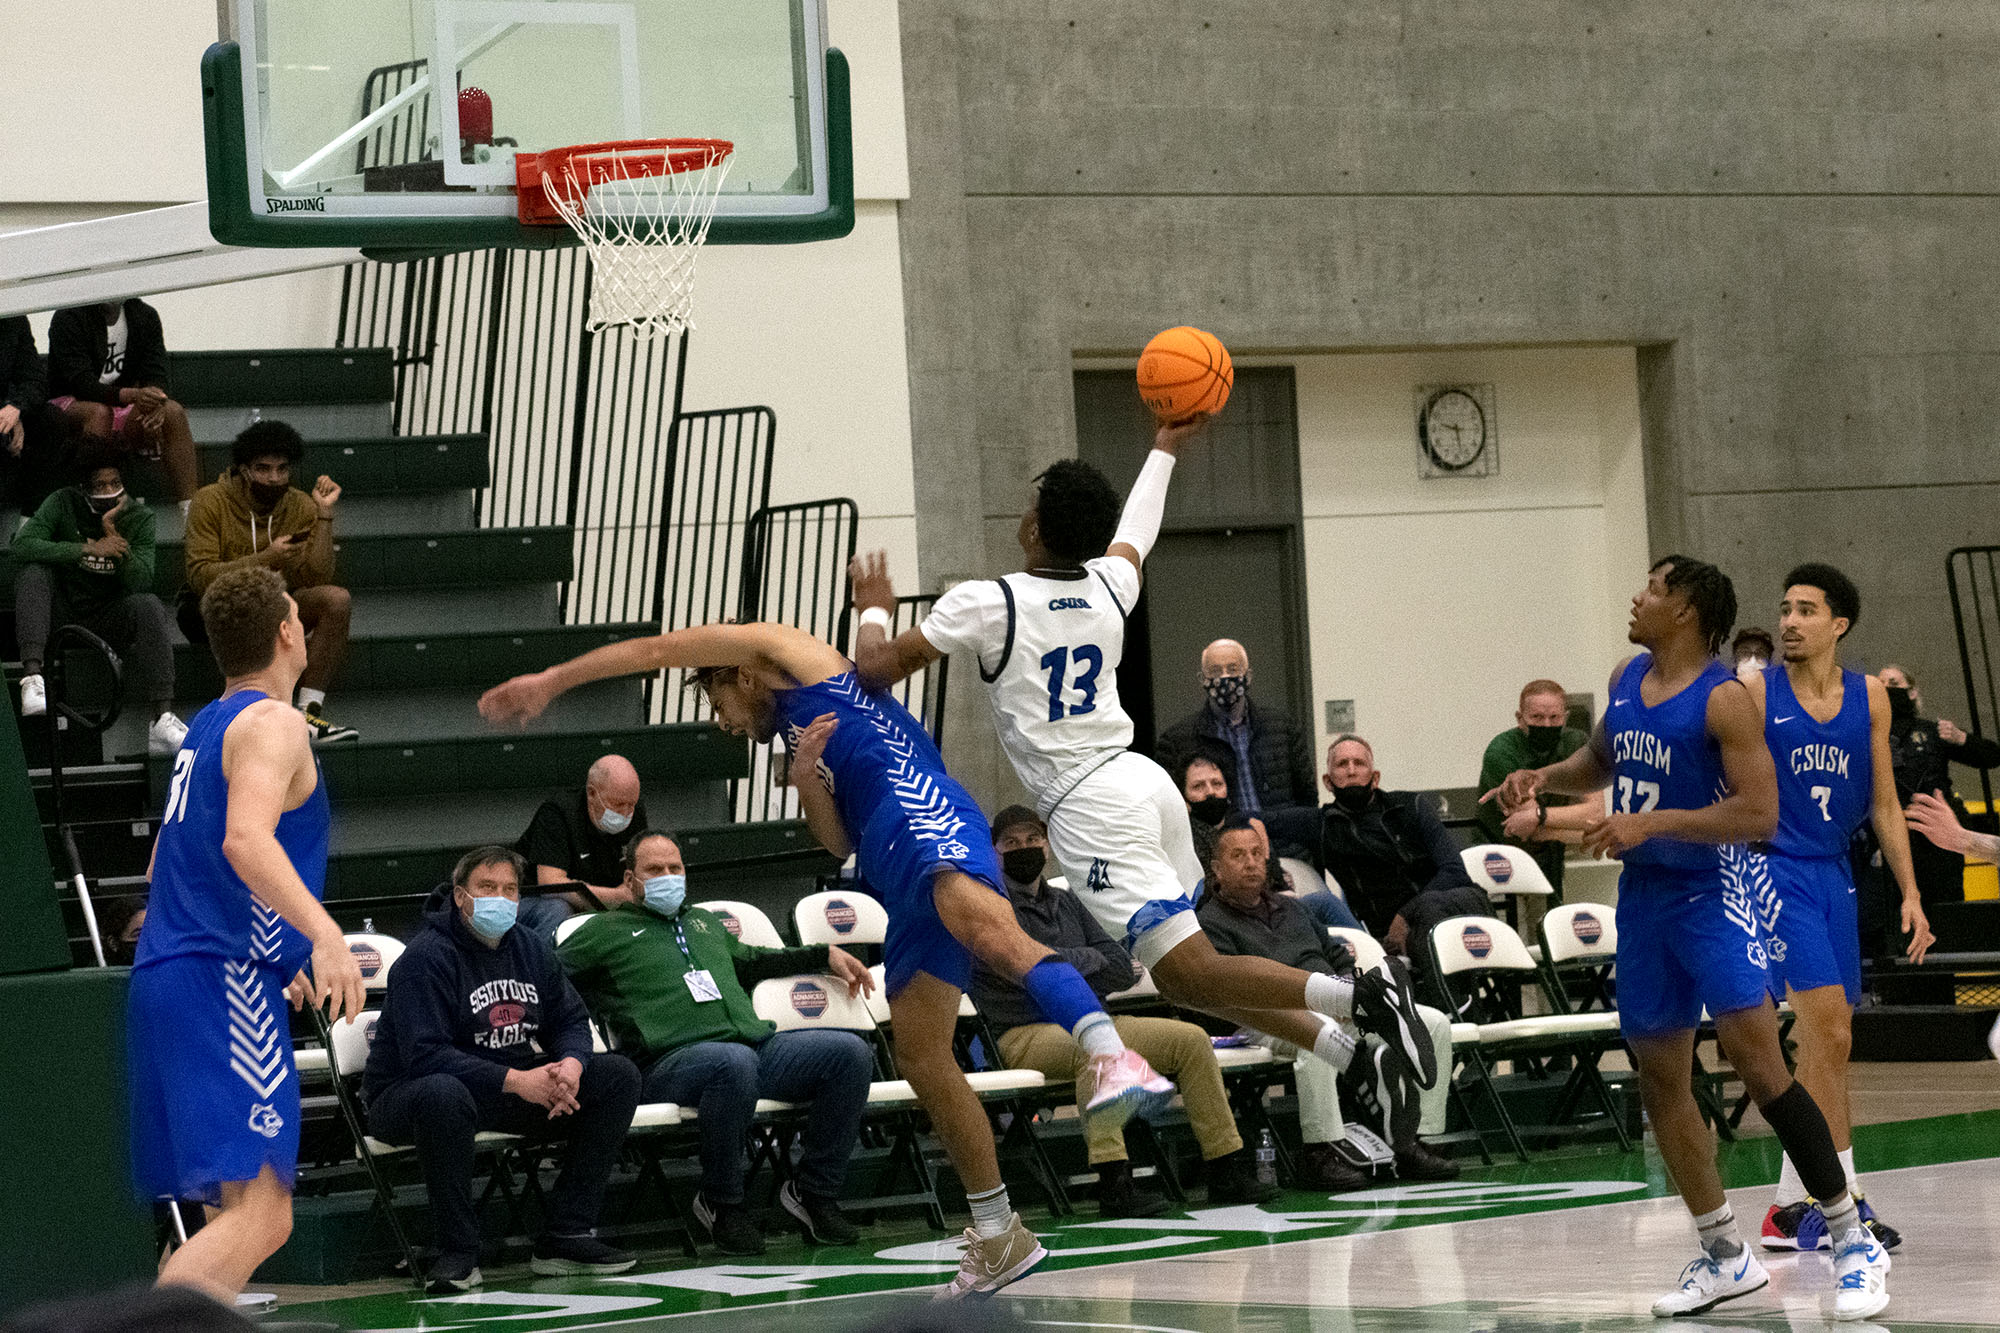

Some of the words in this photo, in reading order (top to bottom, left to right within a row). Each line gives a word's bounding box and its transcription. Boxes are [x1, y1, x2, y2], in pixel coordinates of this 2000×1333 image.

[266, 196, 325, 214] SPALDING
[1040, 643, 1103, 722] 13
[1613, 730, 1672, 777] CSUSM
[1790, 743, 1850, 780] CSUSM
[164, 748, 200, 825] 31
[827, 908, 854, 917] ADVANCED
[793, 992, 825, 1001] ADVANCED
